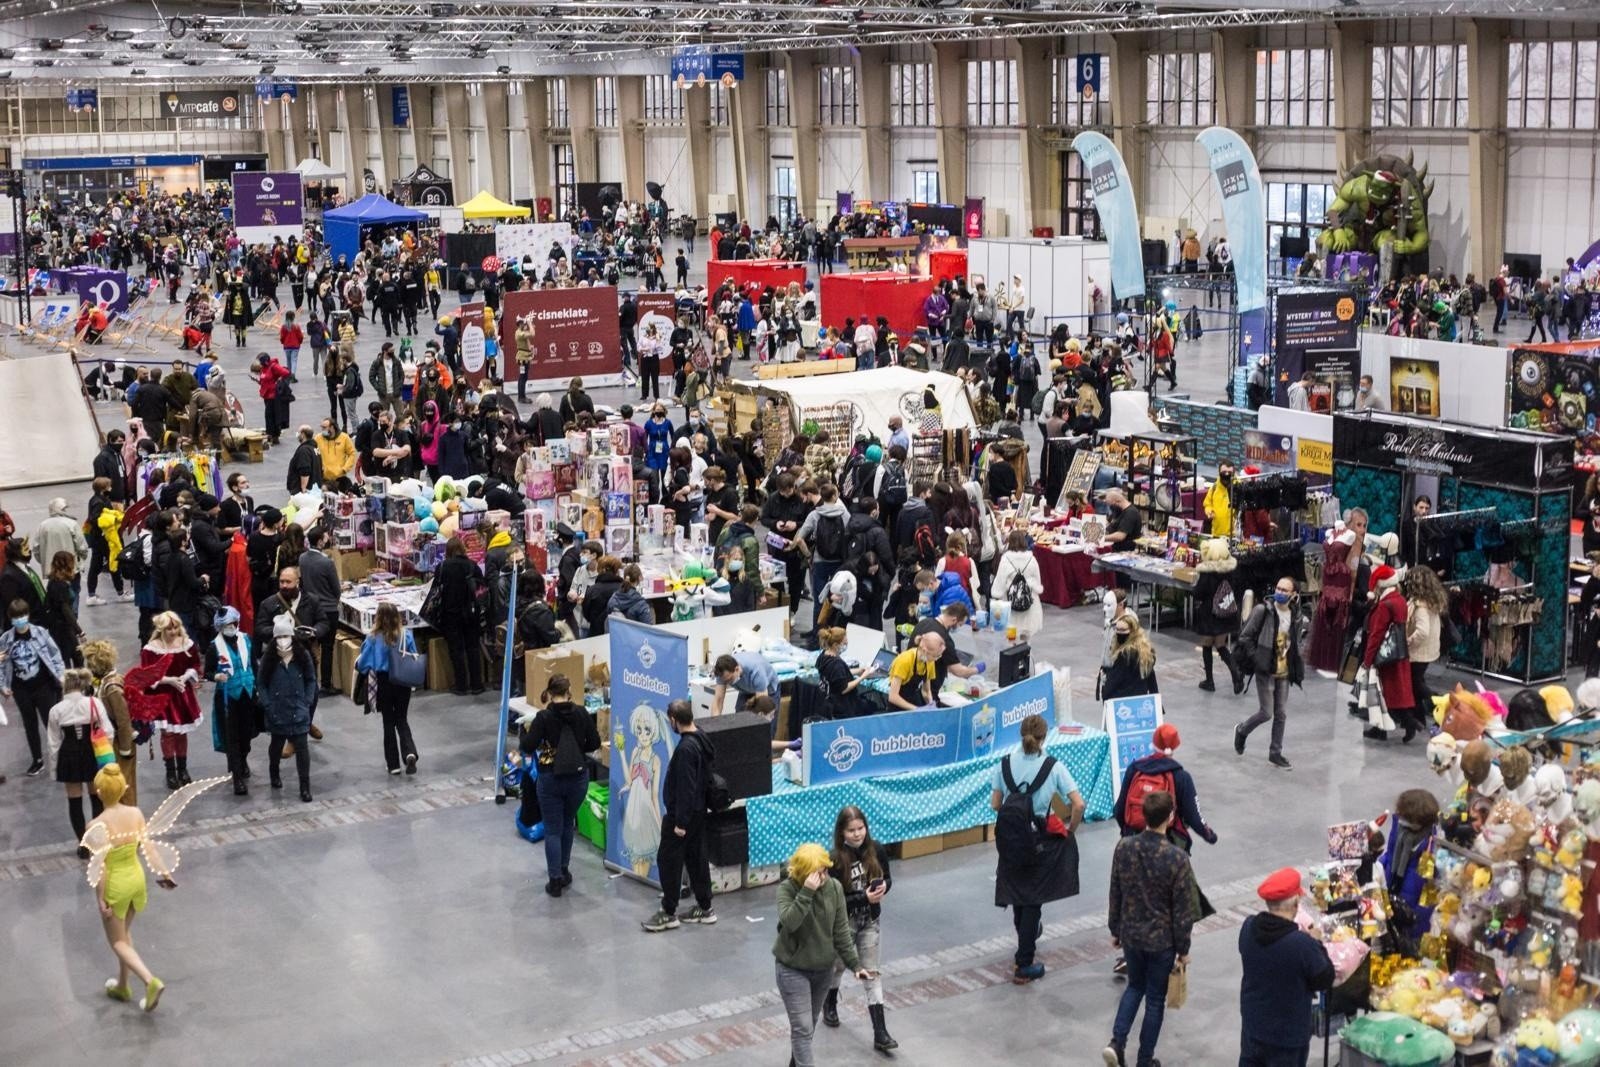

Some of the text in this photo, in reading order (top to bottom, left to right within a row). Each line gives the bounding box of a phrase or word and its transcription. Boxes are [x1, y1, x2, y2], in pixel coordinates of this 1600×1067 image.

[1083, 58, 1093, 81] 6
[180, 101, 219, 113] MTPcafe
[427, 194, 440, 204] BG
[1286, 311, 1332, 321] MYSTERY BOX
[1382, 432, 1473, 464] Rebel Madness
[624, 668, 671, 696] bubbletea
[1003, 697, 1047, 728] bubbletea
[871, 732, 945, 755] bubbletea
